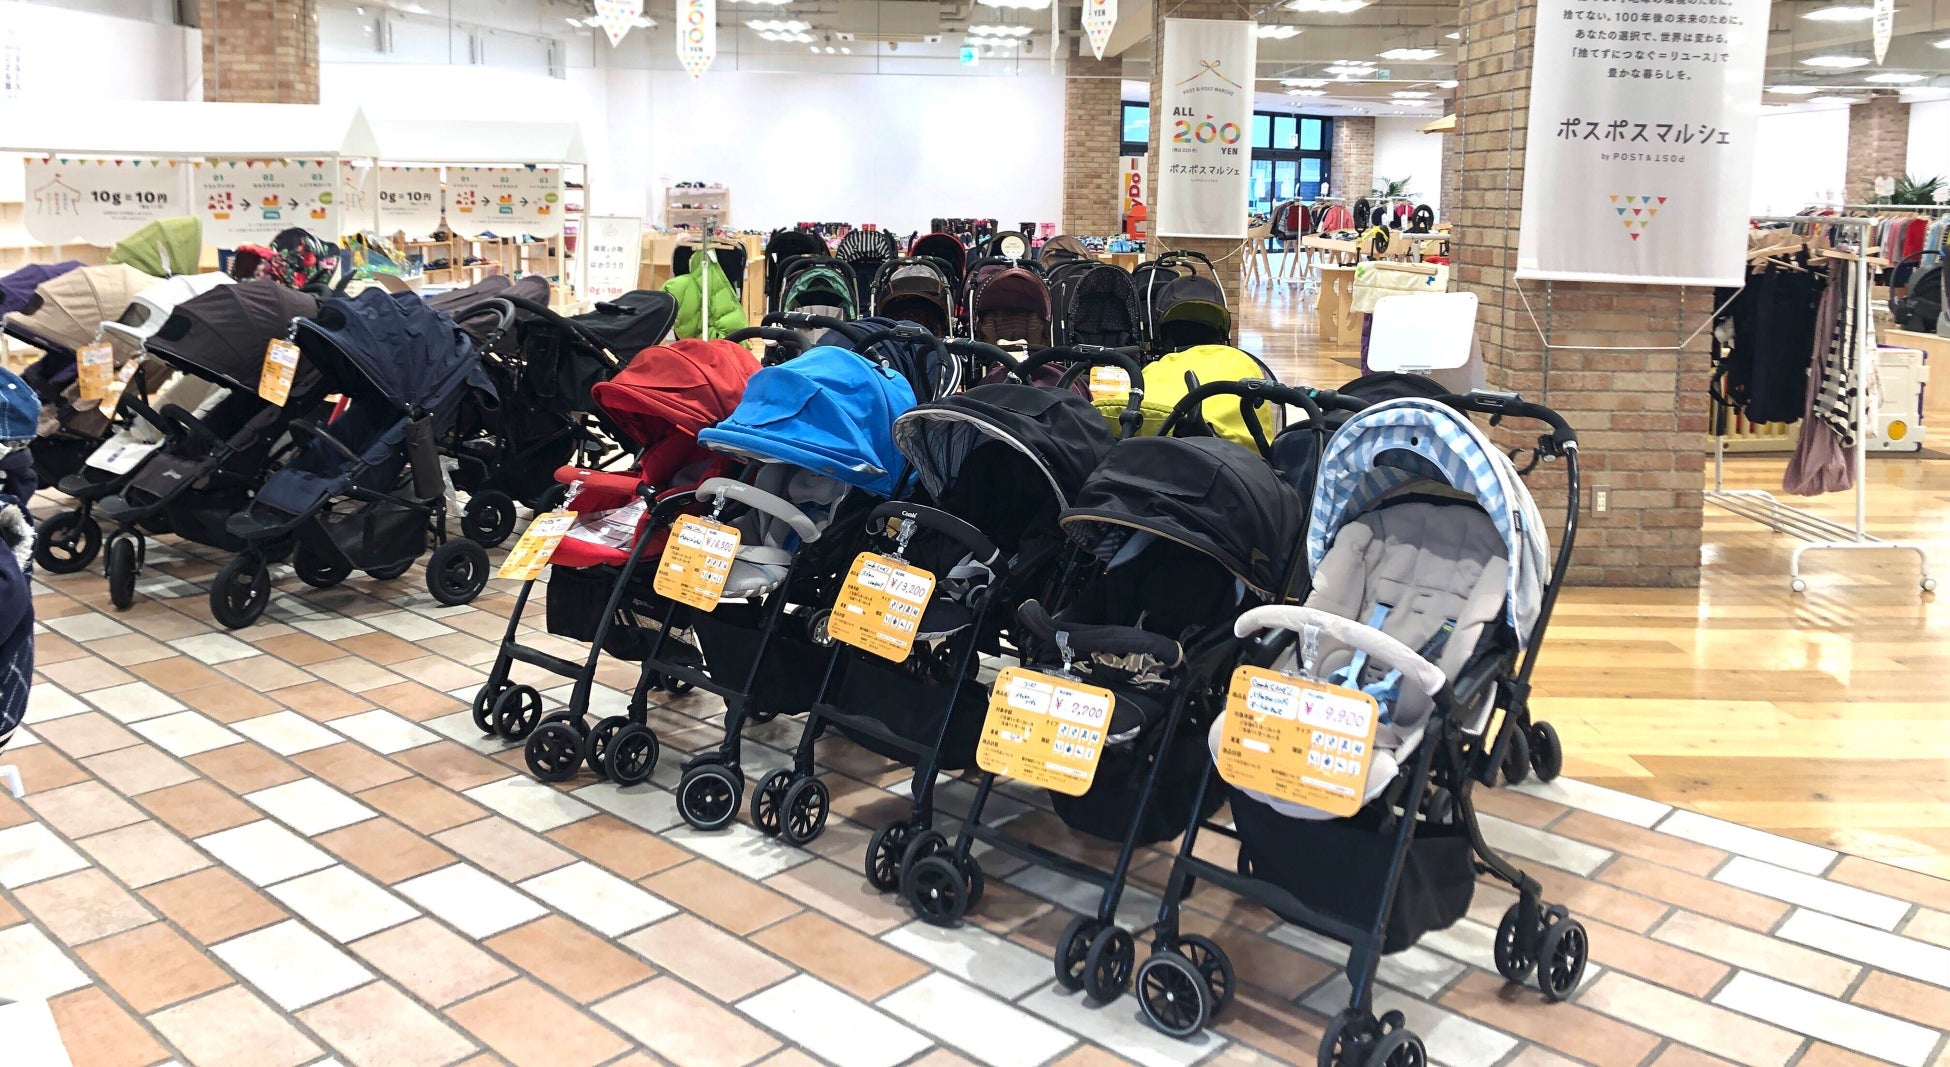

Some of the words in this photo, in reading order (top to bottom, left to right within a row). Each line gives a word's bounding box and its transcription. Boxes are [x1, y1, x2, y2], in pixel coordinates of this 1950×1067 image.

[1607, 68, 1692, 81] 豊かな暮らしを。
[1173, 106, 1195, 117] ALL
[1173, 119, 1241, 144] 200
[1557, 117, 1730, 145] ポスポスマルシェ
[1221, 147, 1238, 155] YEN
[1601, 153, 1610, 161] by
[1170, 164, 1240, 176] ポスポスマルシェ
[901, 510, 918, 519] Combi
[890, 578, 926, 598] ¥13,200
